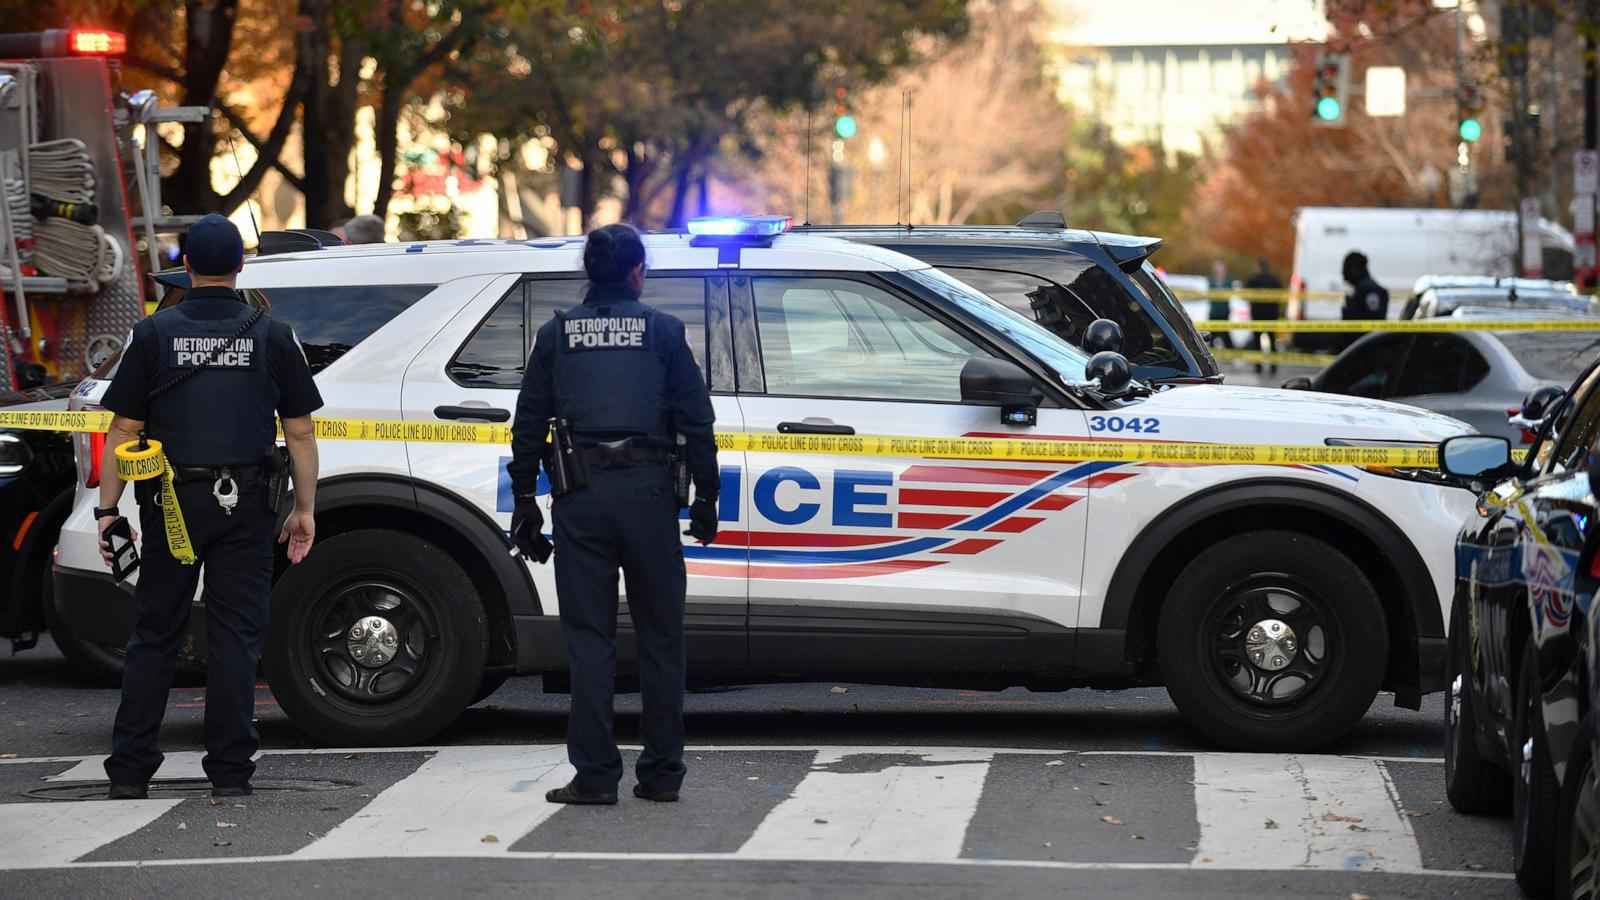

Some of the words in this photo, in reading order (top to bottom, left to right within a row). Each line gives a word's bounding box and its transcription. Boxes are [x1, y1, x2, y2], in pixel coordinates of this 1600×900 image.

[564, 317, 646, 335] METROPOLITAN
[568, 332, 643, 349] POLICE
[10, 412, 28, 425] LINE
[29, 412, 41, 426] DO
[42, 412, 59, 427] NOT
[60, 413, 86, 428] CROSS
[1090, 415, 1161, 434] 3042
[322, 420, 348, 438] CROSS
[375, 423, 400, 439] POLICE
[403, 423, 419, 440] LINE
[421, 424, 432, 440] DO
[434, 424, 449, 441] NOT
[451, 424, 477, 441] CROSS
[714, 433, 735, 449] ROSS
[761, 435, 788, 450] POLICE
[790, 435, 807, 450] LINE
[808, 437, 819, 451] DO
[821, 437, 836, 452] NOT
[839, 438, 864, 452] CROSS
[891, 439, 918, 453] POLICE
[919, 440, 936, 454] LINE
[937, 440, 948, 454] DO
[950, 440, 965, 455] NOT
[967, 441, 992, 455] CROSS
[1283, 448, 1310, 462] POLICE
[1312, 448, 1329, 462] LINE
[1331, 448, 1342, 463] DO
[1344, 448, 1360, 463] NOT
[1362, 449, 1388, 464] CROSS
[1417, 448, 1439, 465] POLI
[136, 455, 160, 475] CROSS
[496, 456, 894, 527] ICE
[167, 525, 186, 550] POLICE
